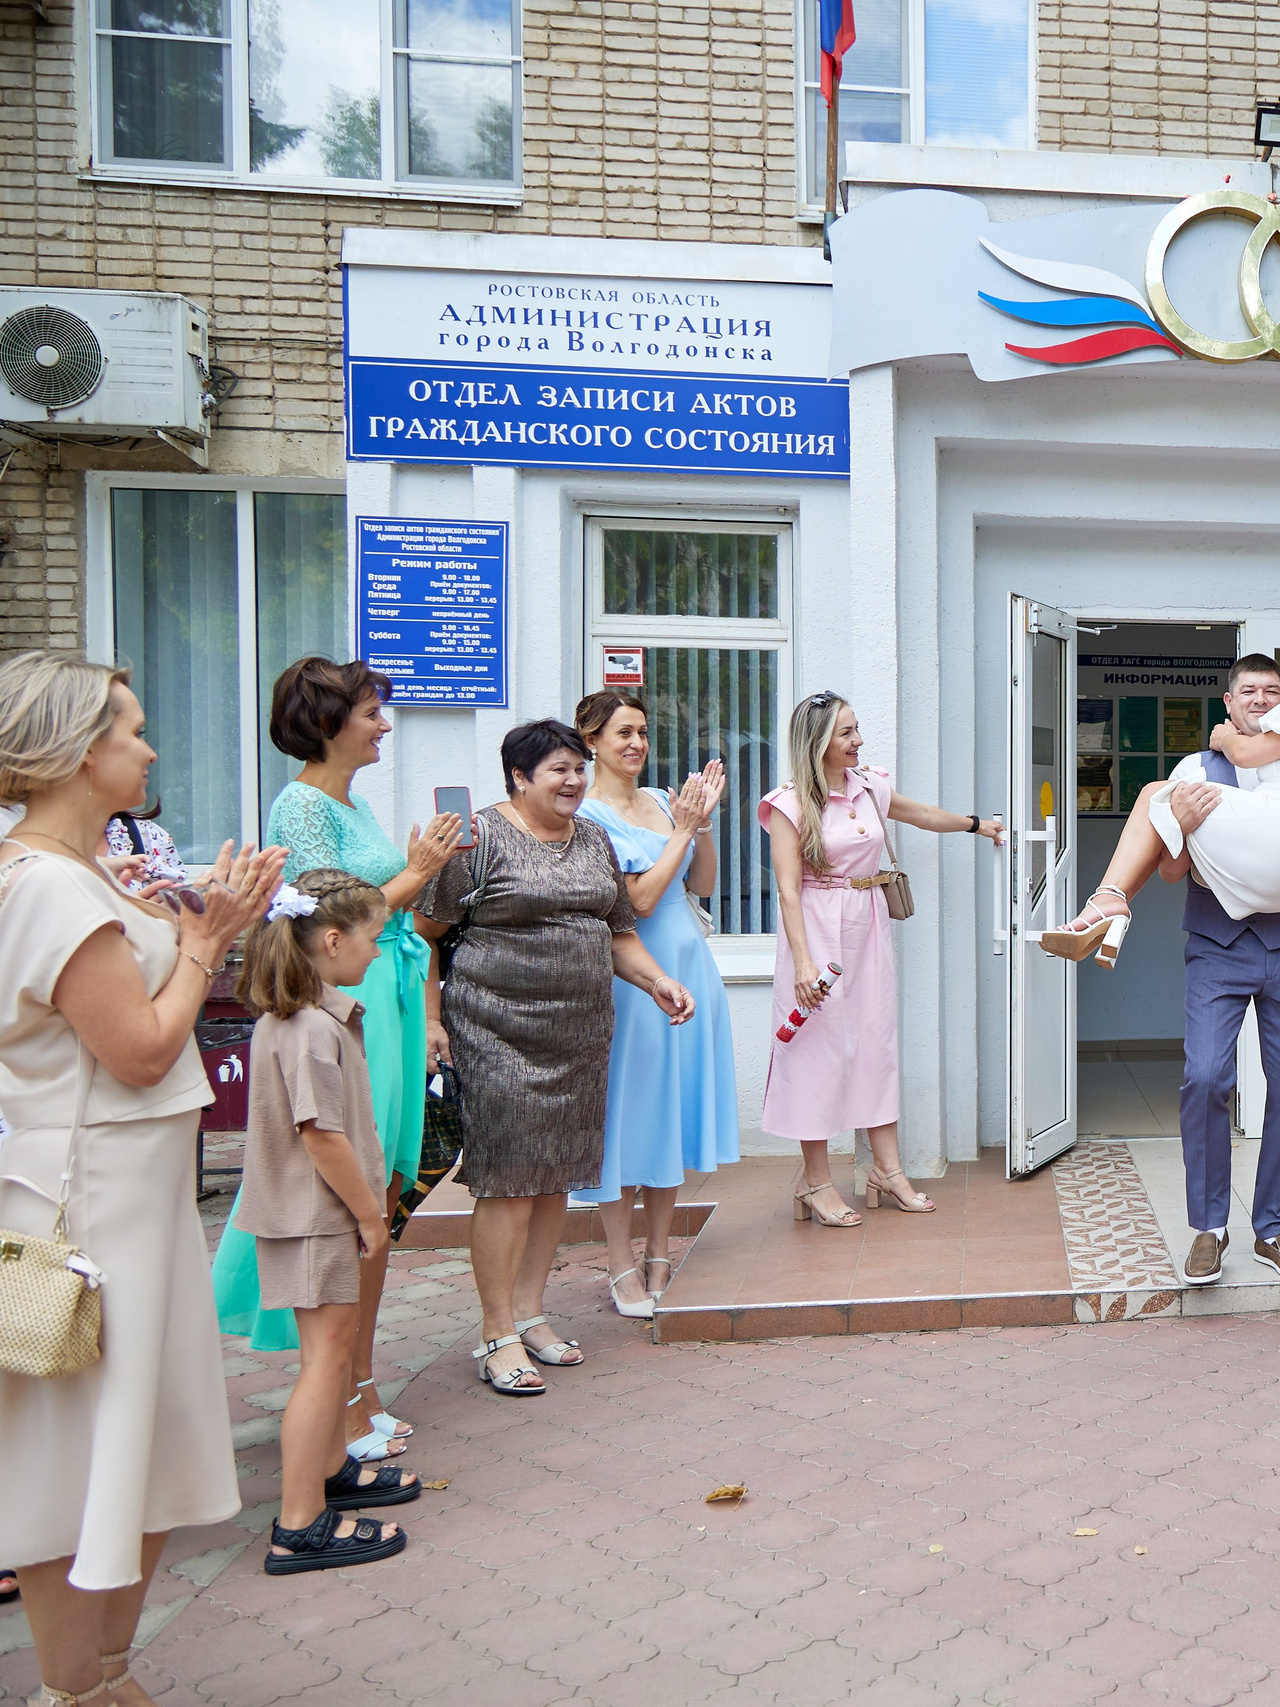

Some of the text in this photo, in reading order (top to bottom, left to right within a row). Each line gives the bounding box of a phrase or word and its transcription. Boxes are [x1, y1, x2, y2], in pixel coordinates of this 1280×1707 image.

[488, 283, 721, 308] РОСТОВСКАЯ ОБЛАСТЬ
[439, 303, 772, 340] АДМИНИСТРАЦИЯ
[439, 330, 773, 361] города Волгодонска
[408, 379, 797, 418] ОТДЕЛ ЗАПИСИ АКТОВ
[368, 416, 835, 456] ГРАЖДАНСКОГО СОСТОЯНИЯ
[364, 523, 382, 532] Отдел
[377, 533, 423, 542] Администрации
[448, 536, 486, 544] Волгодонска
[402, 543, 462, 552] Ростовской области
[392, 558, 477, 570] Режим работы
[368, 574, 401, 582] Вторник
[373, 582, 396, 590] Среда
[430, 581, 451, 589] Приём
[368, 591, 401, 600] Пятница
[368, 608, 400, 616] Четверг
[369, 632, 400, 640] Суббота
[369, 658, 413, 666] Воскресенье
[1092, 656, 1119, 665] ОТДЕЛ
[434, 664, 472, 672] Выходные
[1104, 673, 1218, 686] ИНФОРМАЦИЯ
